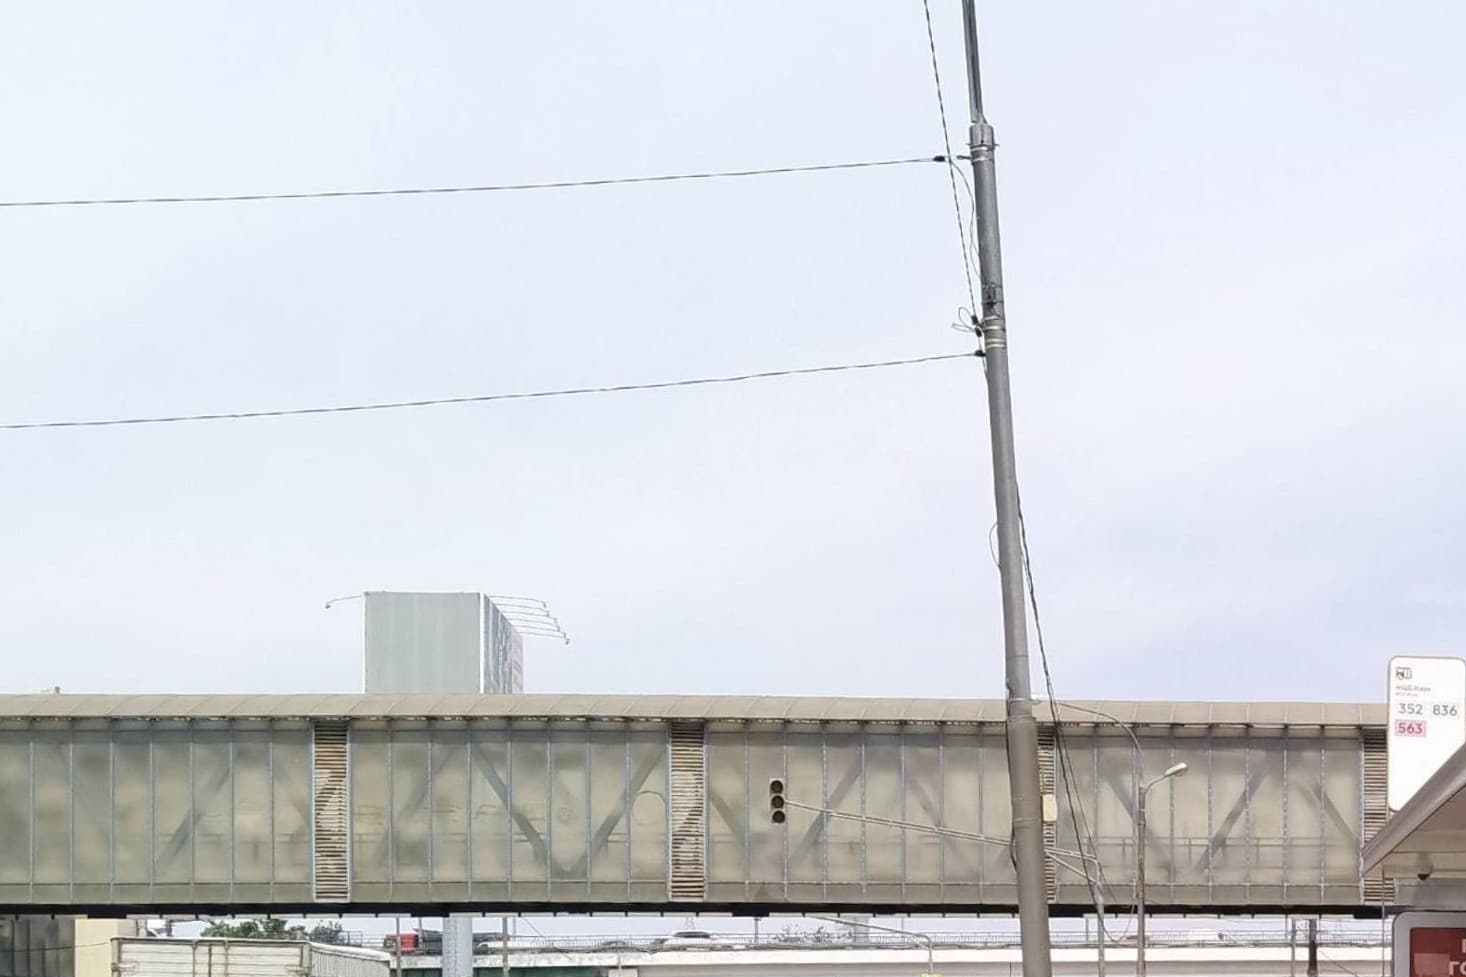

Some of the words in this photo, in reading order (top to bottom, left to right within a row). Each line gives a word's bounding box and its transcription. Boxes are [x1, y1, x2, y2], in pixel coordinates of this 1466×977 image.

[1398, 703, 1423, 715] 352
[1432, 704, 1458, 716] 836
[1398, 722, 1423, 734] 563
